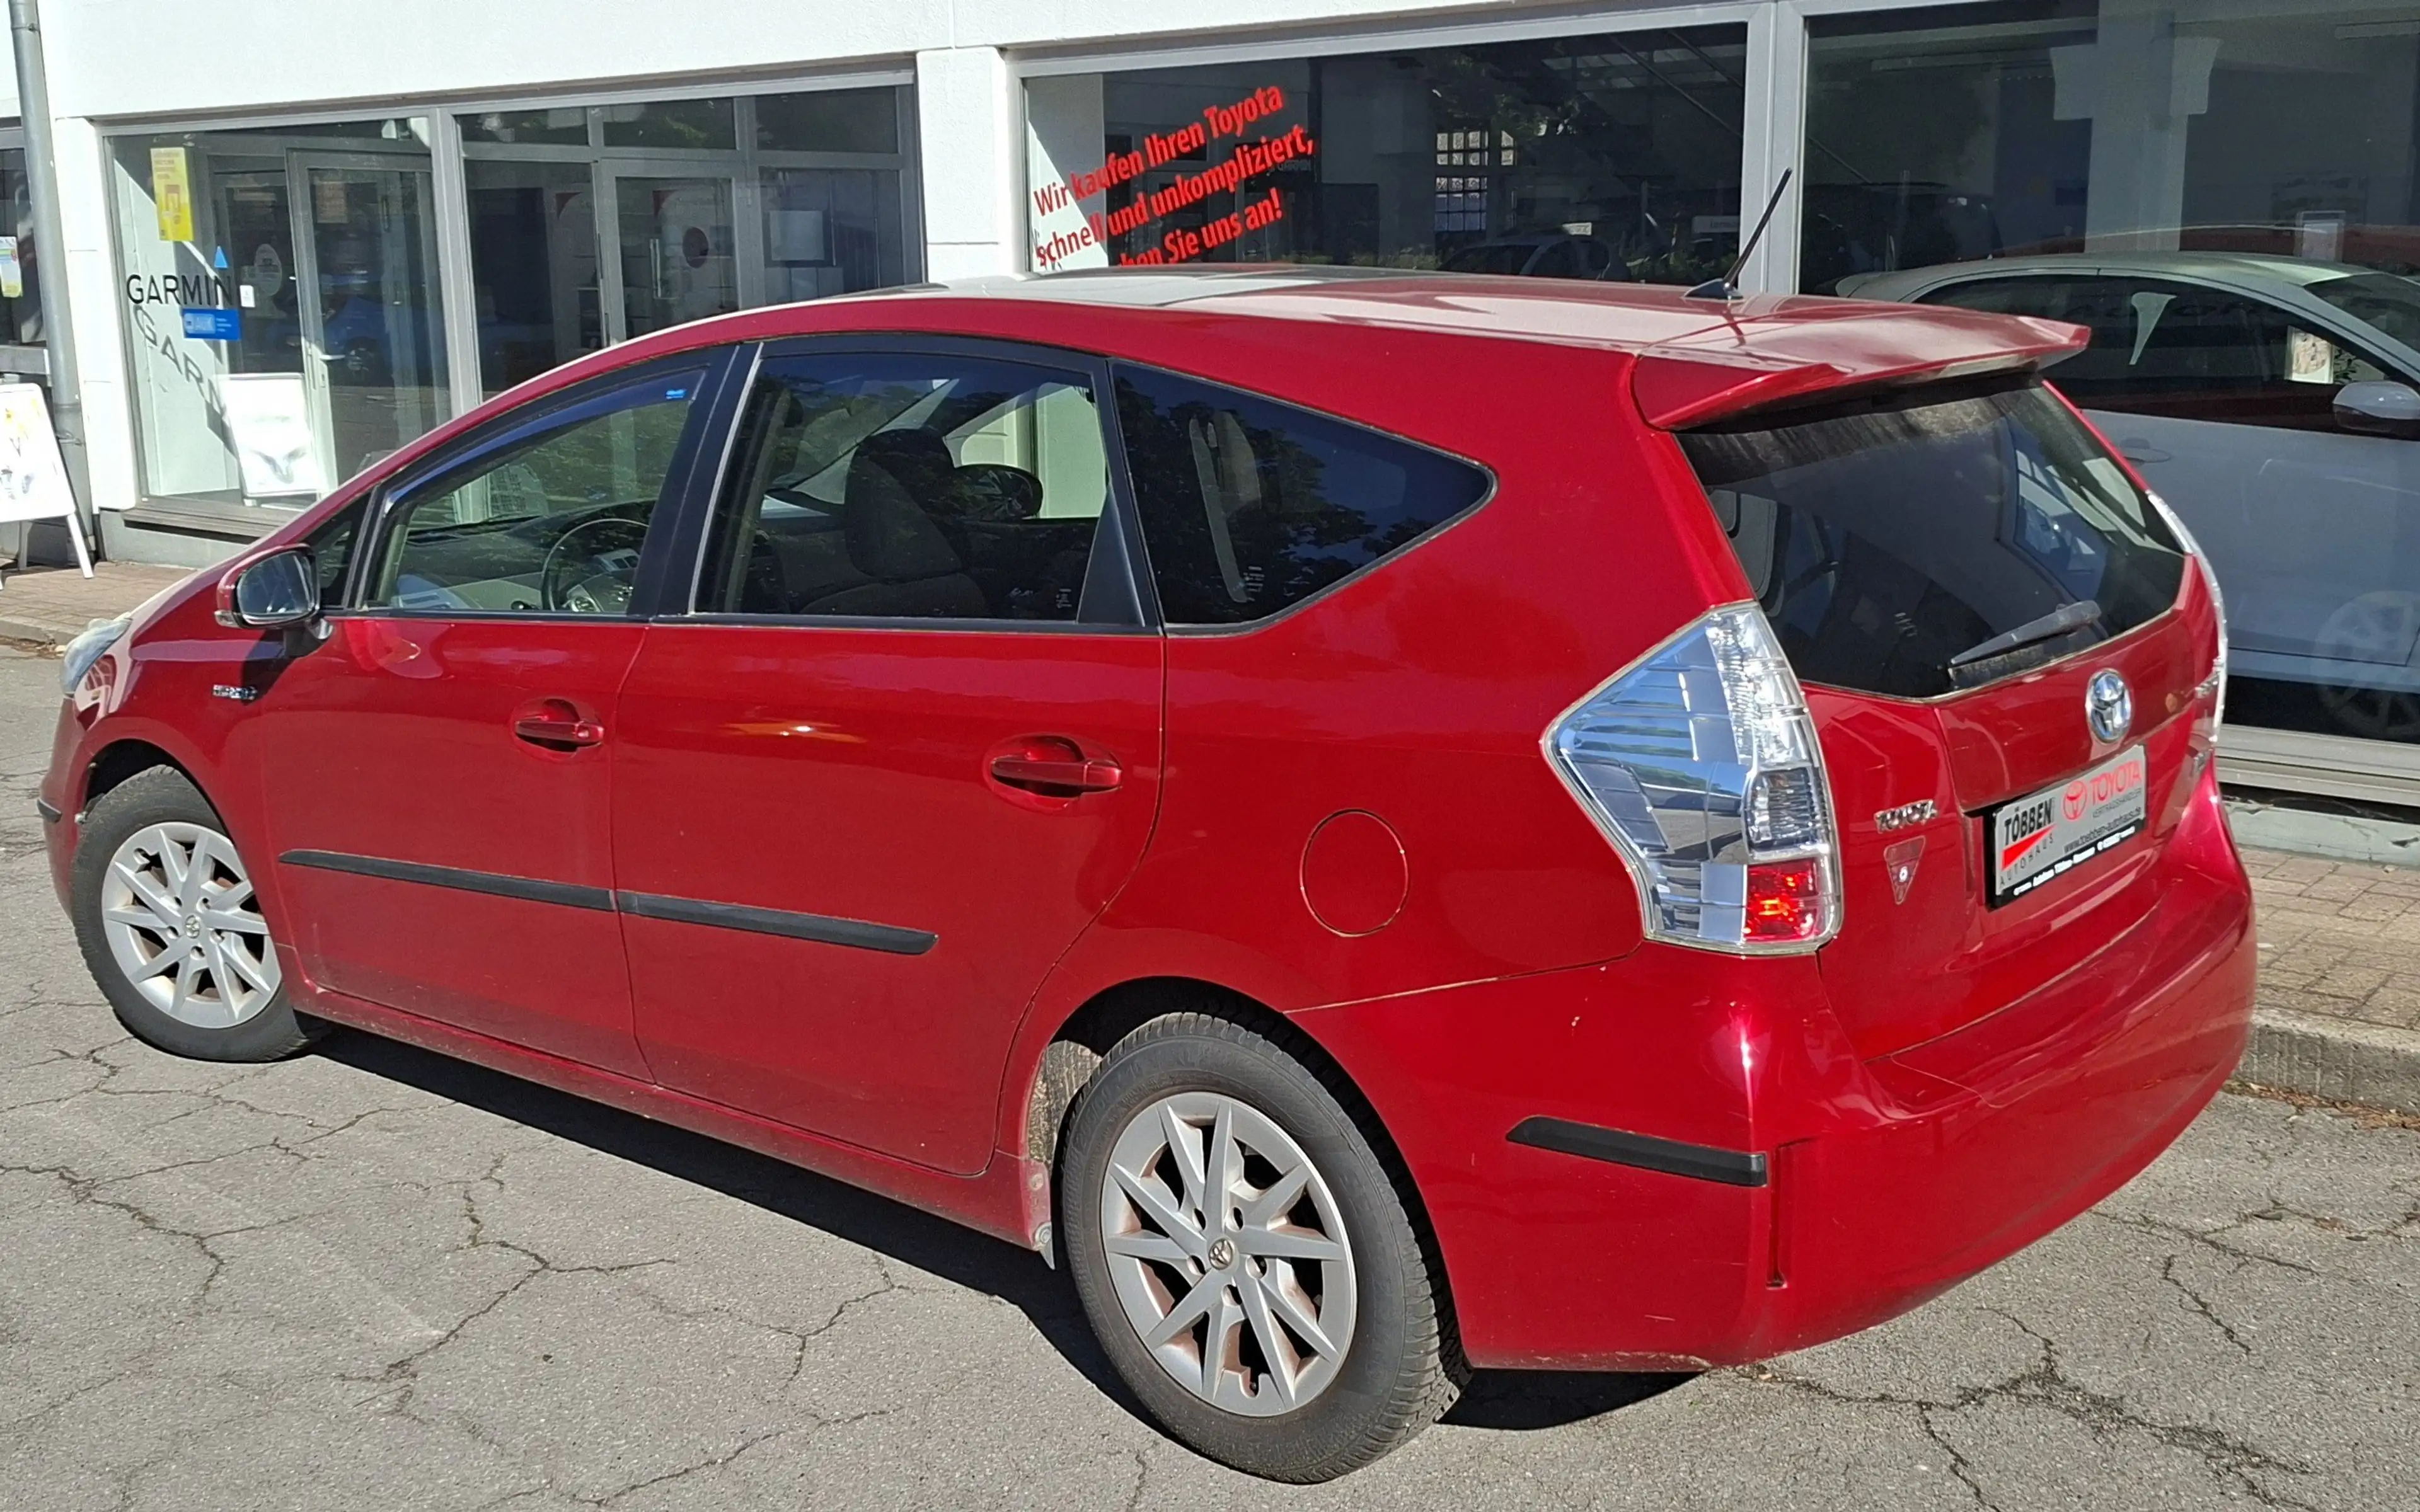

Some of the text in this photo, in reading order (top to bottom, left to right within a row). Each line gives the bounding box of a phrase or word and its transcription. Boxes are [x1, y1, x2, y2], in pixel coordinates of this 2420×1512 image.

[1034, 86, 1283, 217] Wir kaufen Ihren Toyota
[1035, 124, 1313, 267] schnell und unkompliziert,
[1164, 229, 1200, 264] Sie
[1201, 212, 1243, 249] uns
[1245, 187, 1282, 230] an!
[127, 274, 234, 305] GARMIN
[2089, 760, 2142, 806] TOYOTA
[2004, 798, 2053, 845] TÖBBEN
[2000, 833, 2054, 885] AUTOHAUS
